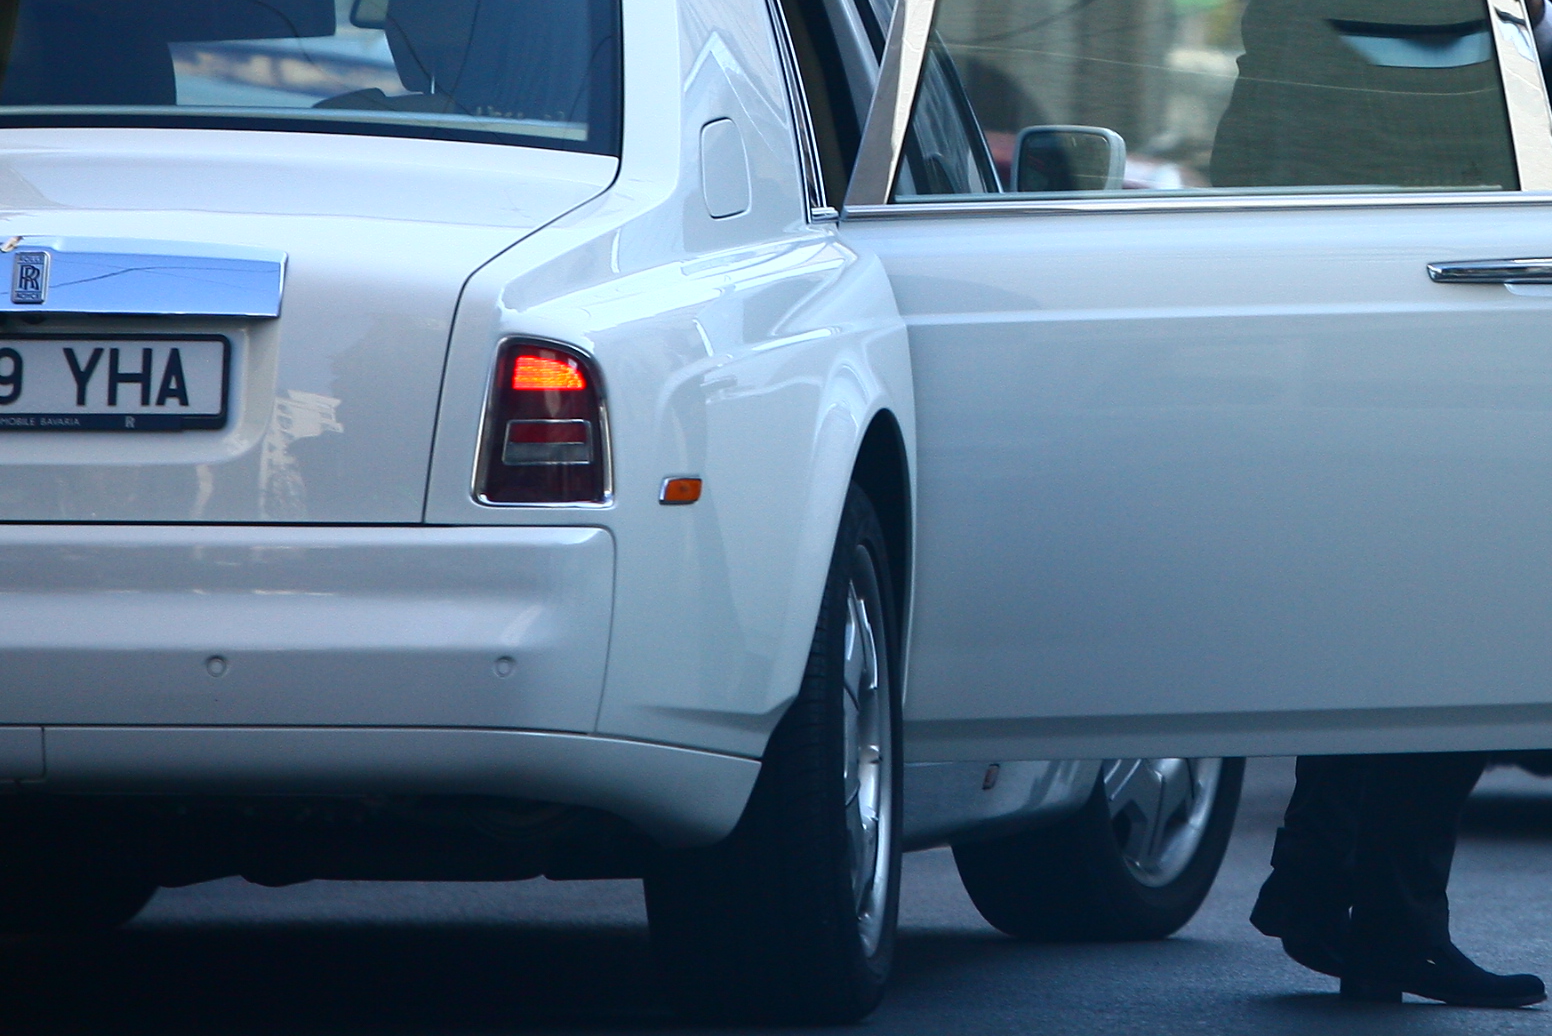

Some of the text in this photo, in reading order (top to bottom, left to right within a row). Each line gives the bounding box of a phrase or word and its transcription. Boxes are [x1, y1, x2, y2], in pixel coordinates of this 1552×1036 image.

[0, 347, 189, 406] 9 YHA
[40, 417, 80, 426] BAVARIA
